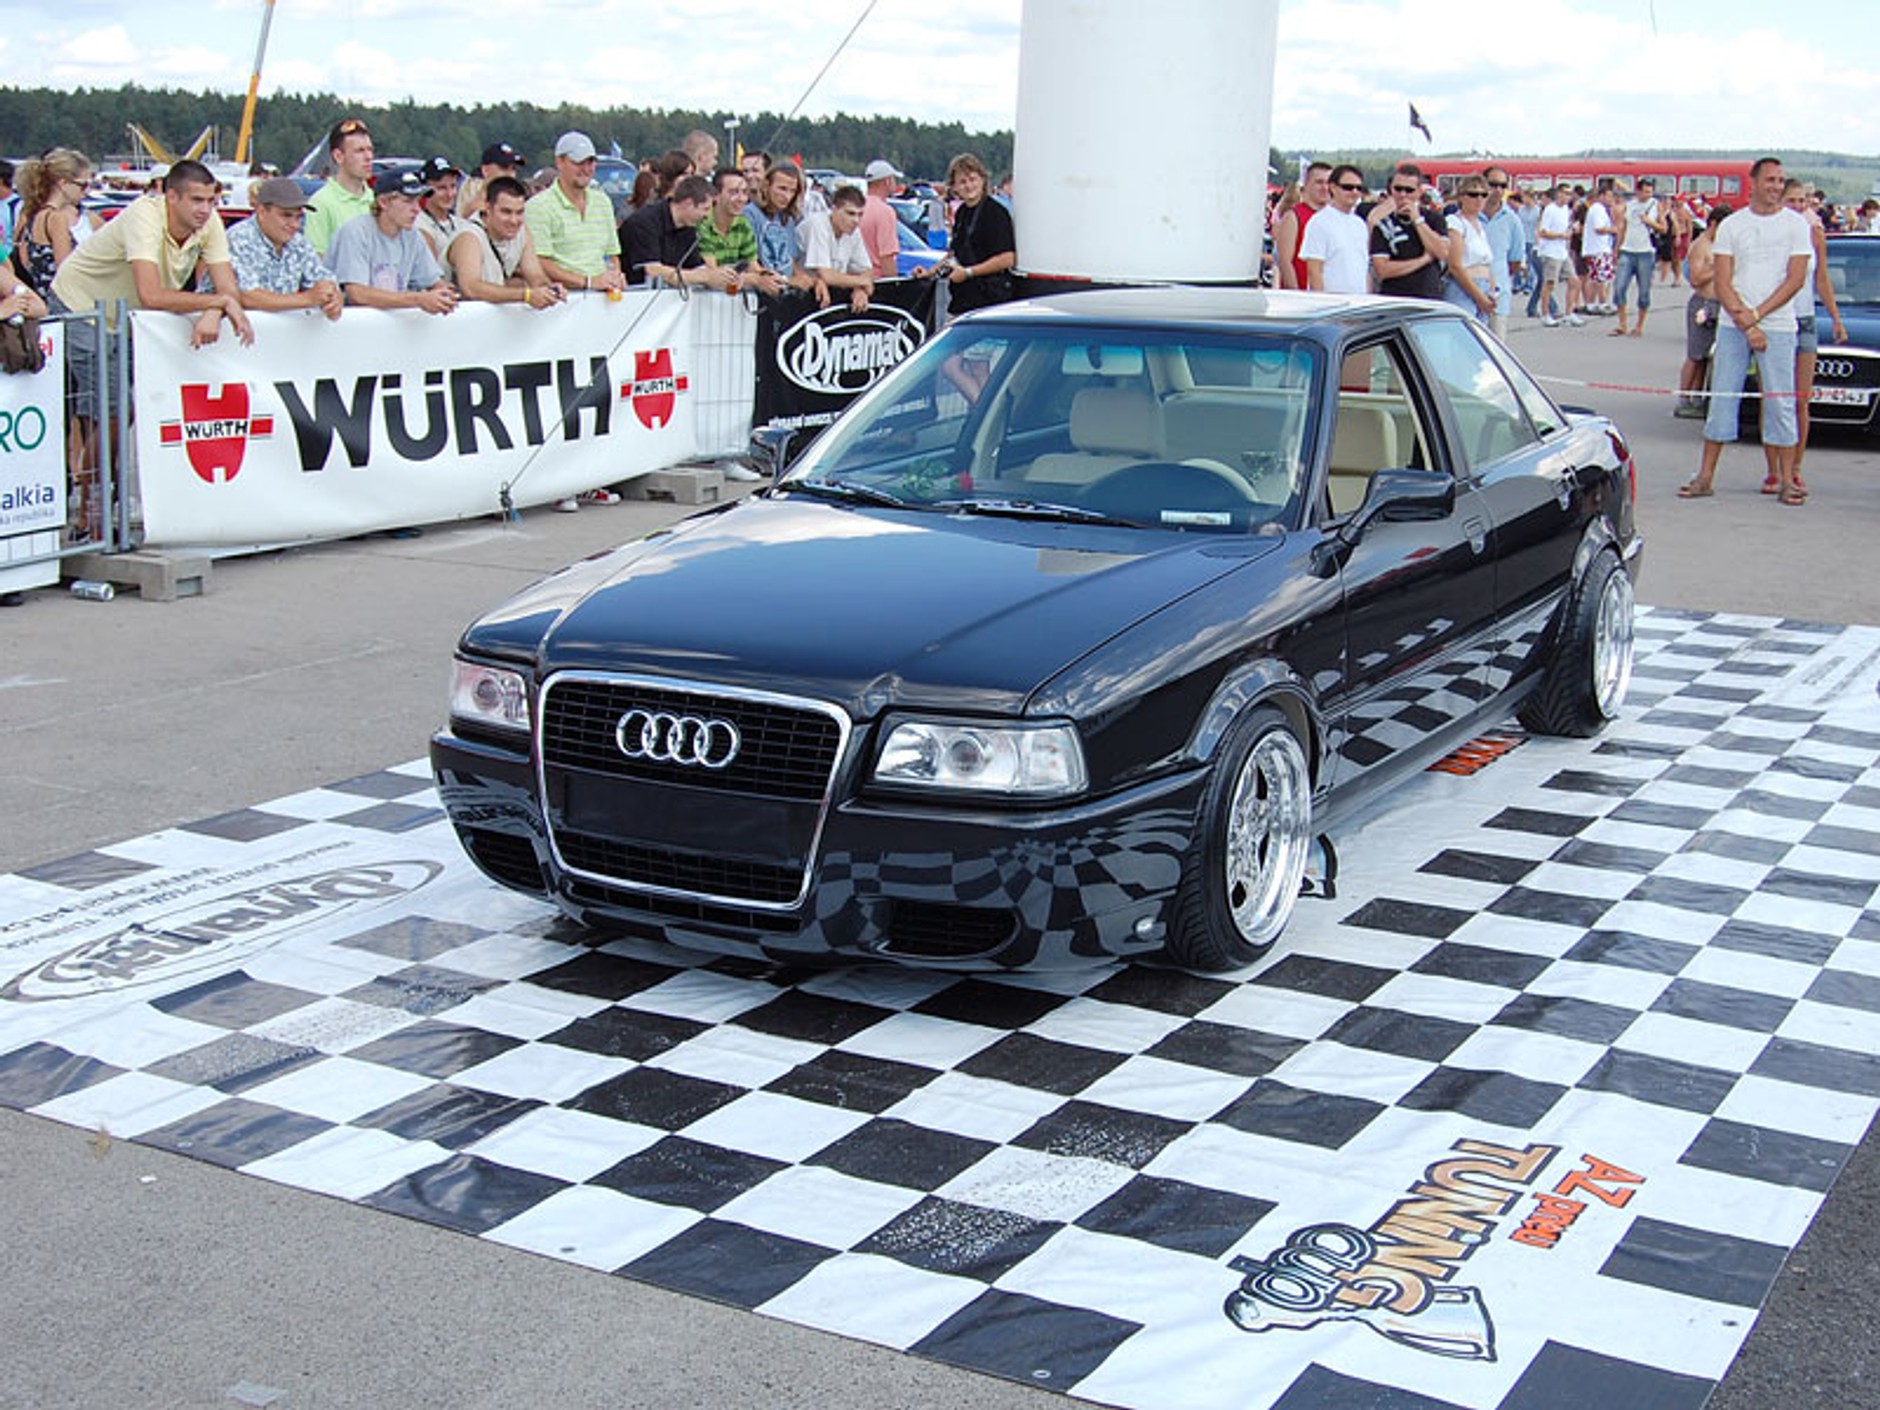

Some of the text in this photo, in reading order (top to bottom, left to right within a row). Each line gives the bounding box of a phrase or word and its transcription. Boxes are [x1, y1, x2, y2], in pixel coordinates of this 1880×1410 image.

[802, 319, 905, 385] Dynamat
[273, 355, 612, 472] WÜRTH
[1552, 1153, 1648, 1209] AZ
